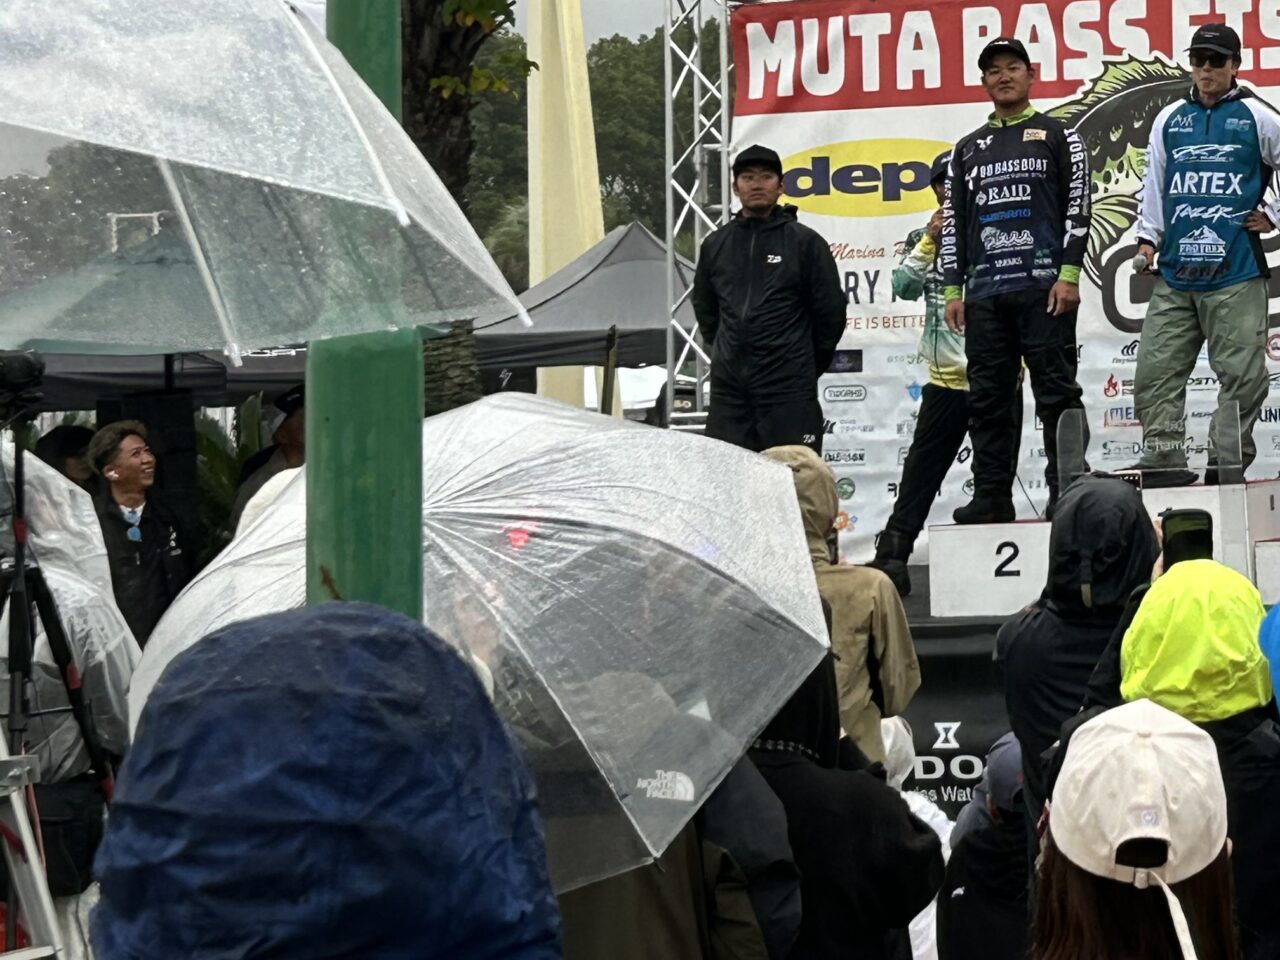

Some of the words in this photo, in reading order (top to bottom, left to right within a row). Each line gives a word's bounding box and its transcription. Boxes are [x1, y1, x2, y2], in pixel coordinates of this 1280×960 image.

[746, 10, 941, 100] MUTA
[987, 183, 1031, 202] RAID
[1169, 170, 1243, 195] ARTEX
[994, 541, 1021, 578] 2
